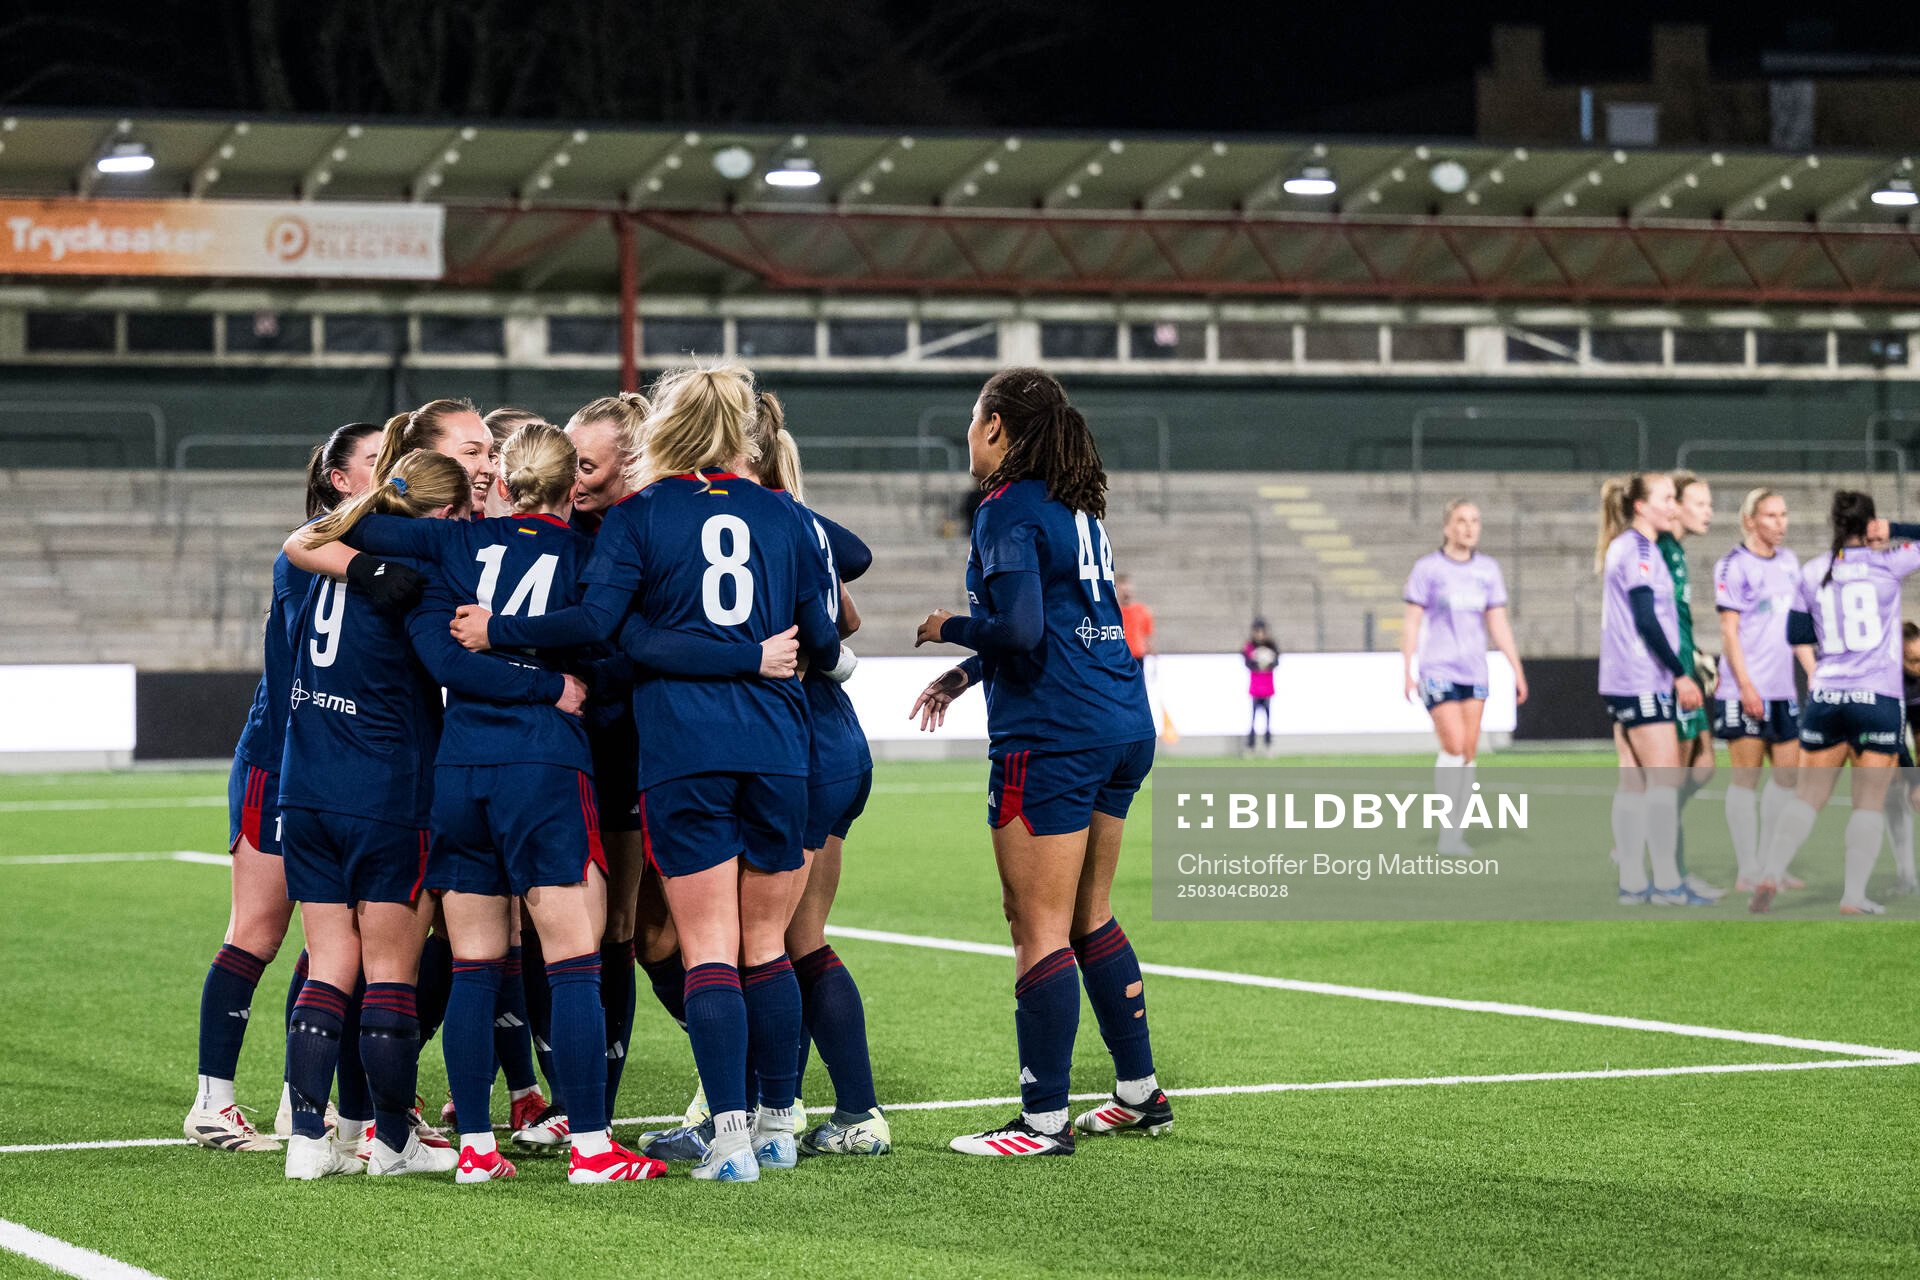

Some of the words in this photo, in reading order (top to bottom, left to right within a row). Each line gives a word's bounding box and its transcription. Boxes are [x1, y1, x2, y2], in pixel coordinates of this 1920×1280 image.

[7, 217, 214, 261] Trycksaker
[475, 544, 559, 617] 14
[701, 514, 753, 626] 8
[1075, 509, 1117, 601] 44
[310, 577, 347, 667] 9
[1816, 582, 1882, 654] 18
